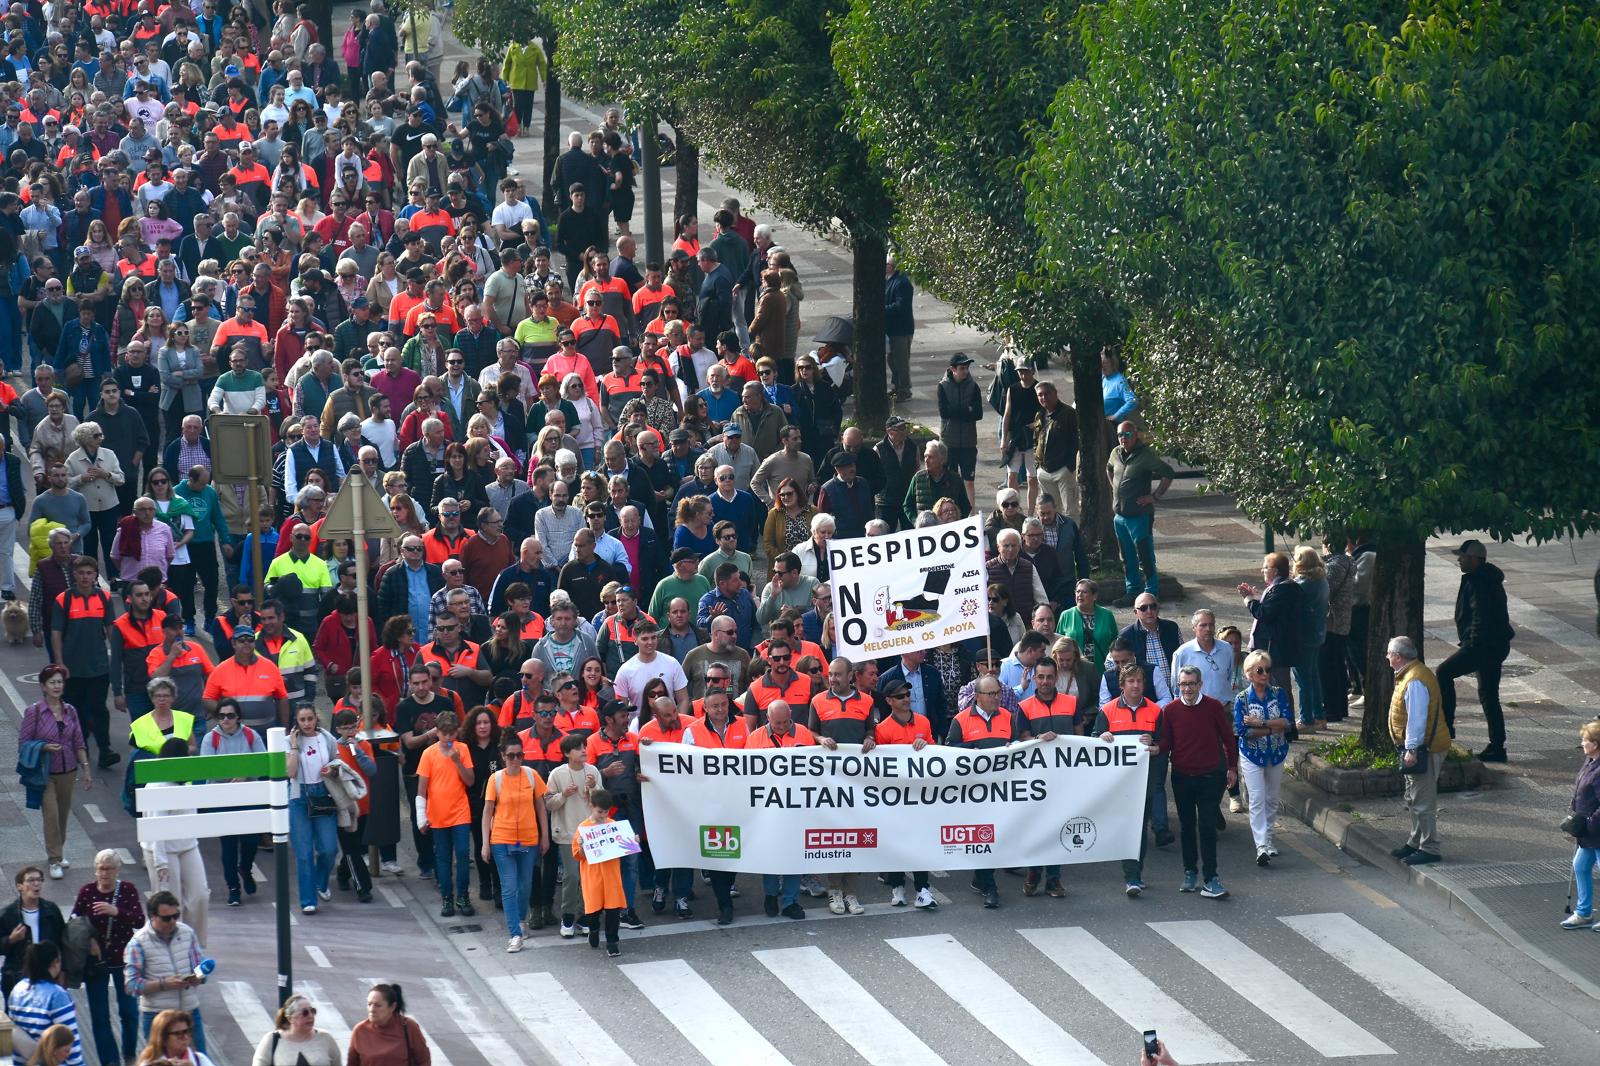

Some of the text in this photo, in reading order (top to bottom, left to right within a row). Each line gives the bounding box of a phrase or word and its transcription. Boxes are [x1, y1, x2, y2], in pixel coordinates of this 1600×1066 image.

[830, 525, 980, 571] DESPIDOS
[919, 563, 955, 573] BRIDGESTONE
[962, 569, 980, 579] AZSA
[954, 584, 980, 596] SNIACE
[839, 582, 867, 646] NO
[896, 620, 925, 631] OBRERO
[863, 621, 976, 652] HELGUERA OS APOYA
[658, 745, 1138, 778] EN BRIDGESTONE NO SOBRA NADIE
[750, 779, 1047, 809] FALTAN SOLUCIONES
[942, 826, 976, 843] UGT
[1065, 822, 1091, 834] SITB
[808, 832, 858, 846] CCOO
[804, 849, 852, 860] industria
[965, 844, 992, 855] FICA
